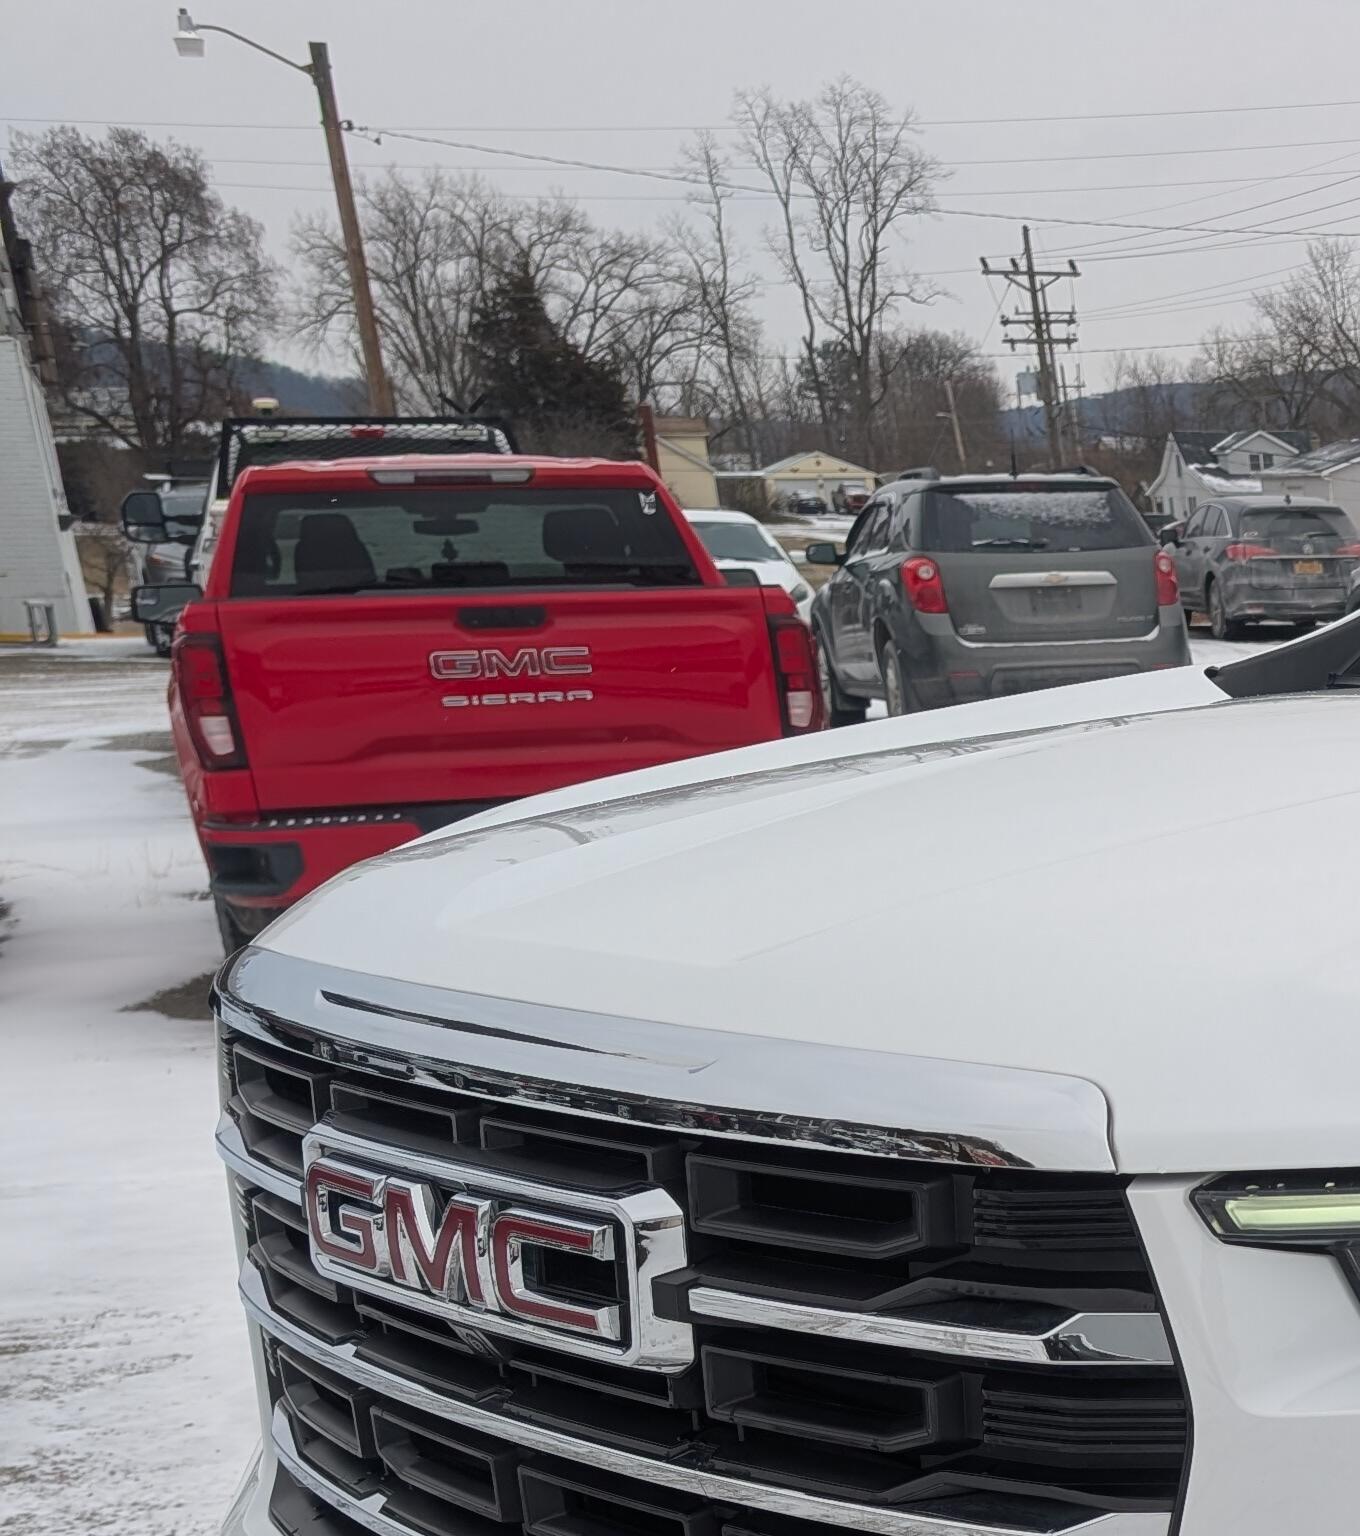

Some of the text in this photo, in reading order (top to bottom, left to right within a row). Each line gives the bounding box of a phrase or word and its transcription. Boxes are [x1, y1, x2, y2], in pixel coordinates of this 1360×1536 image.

[429, 646, 593, 679] GMC
[441, 690, 594, 706] SIERRA
[306, 1155, 624, 1341] GMC
